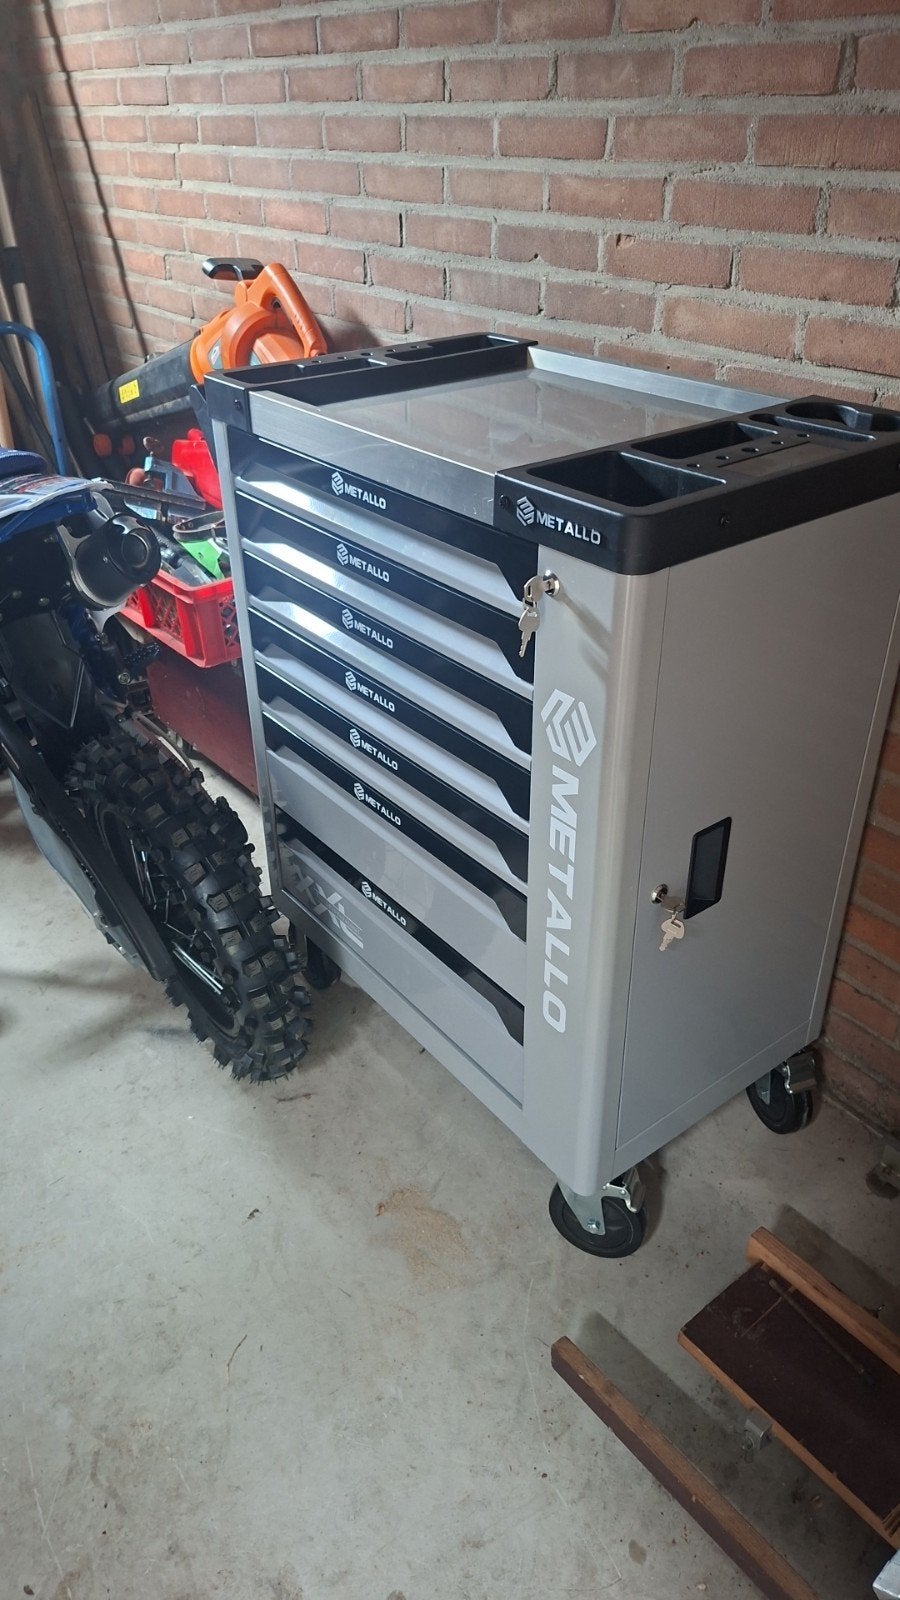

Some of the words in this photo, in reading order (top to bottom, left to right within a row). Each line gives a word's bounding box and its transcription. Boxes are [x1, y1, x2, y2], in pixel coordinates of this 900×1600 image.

[344, 482, 386, 510] METALLO
[536, 511, 601, 545] METALLO
[349, 553, 390, 583] METALLO
[354, 619, 394, 649] METALLO
[357, 682, 395, 712] METALLO
[361, 740, 398, 771] METALLO
[365, 794, 401, 826] METALLO
[372, 893, 407, 926] METALLO
[542, 765, 580, 1034] METALLO
